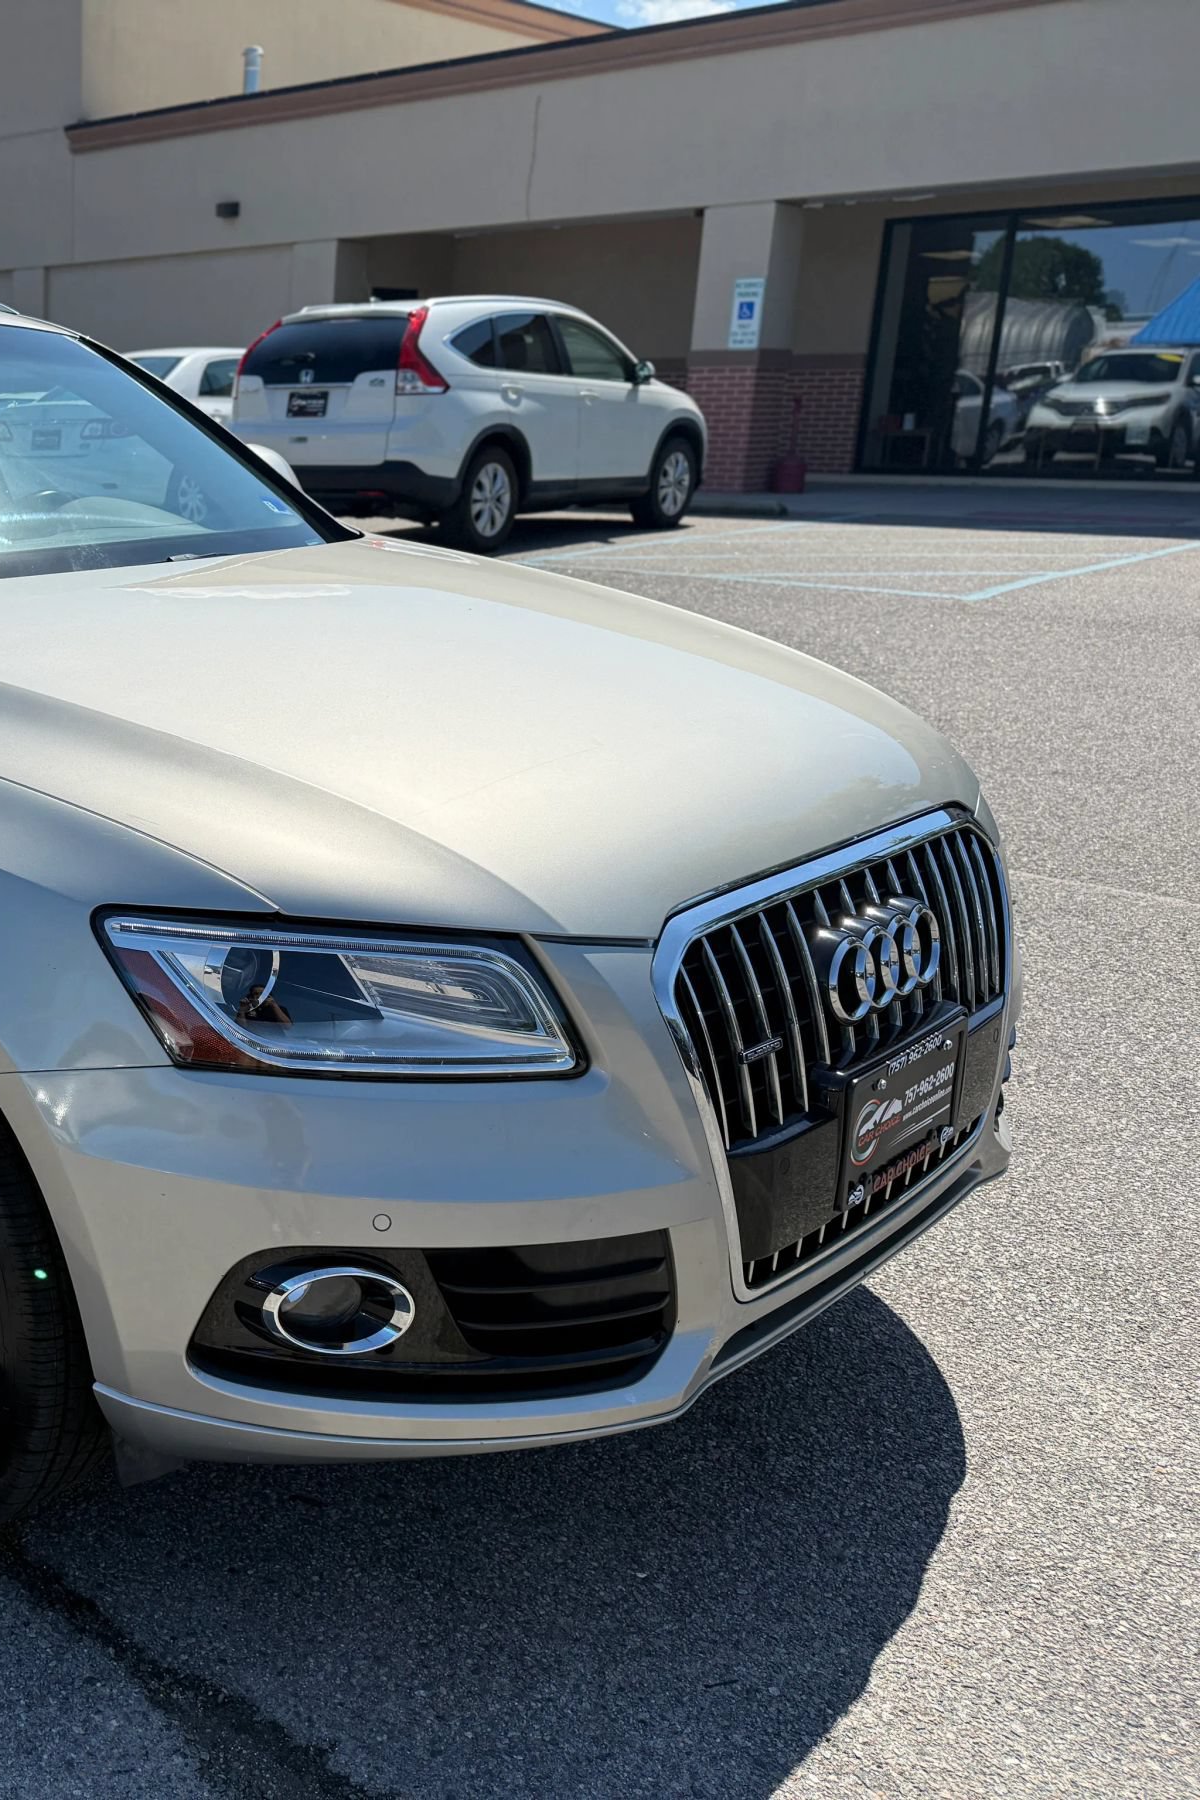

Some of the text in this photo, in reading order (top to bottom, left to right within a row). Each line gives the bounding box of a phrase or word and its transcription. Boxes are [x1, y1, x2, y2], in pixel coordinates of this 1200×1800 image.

[907, 1033, 943, 1065] 962-2600
[904, 1062, 955, 1107] 757-962-2600
[858, 1113, 903, 1147] CAR CHOICE
[873, 1141, 931, 1192] CAR CHOICE
